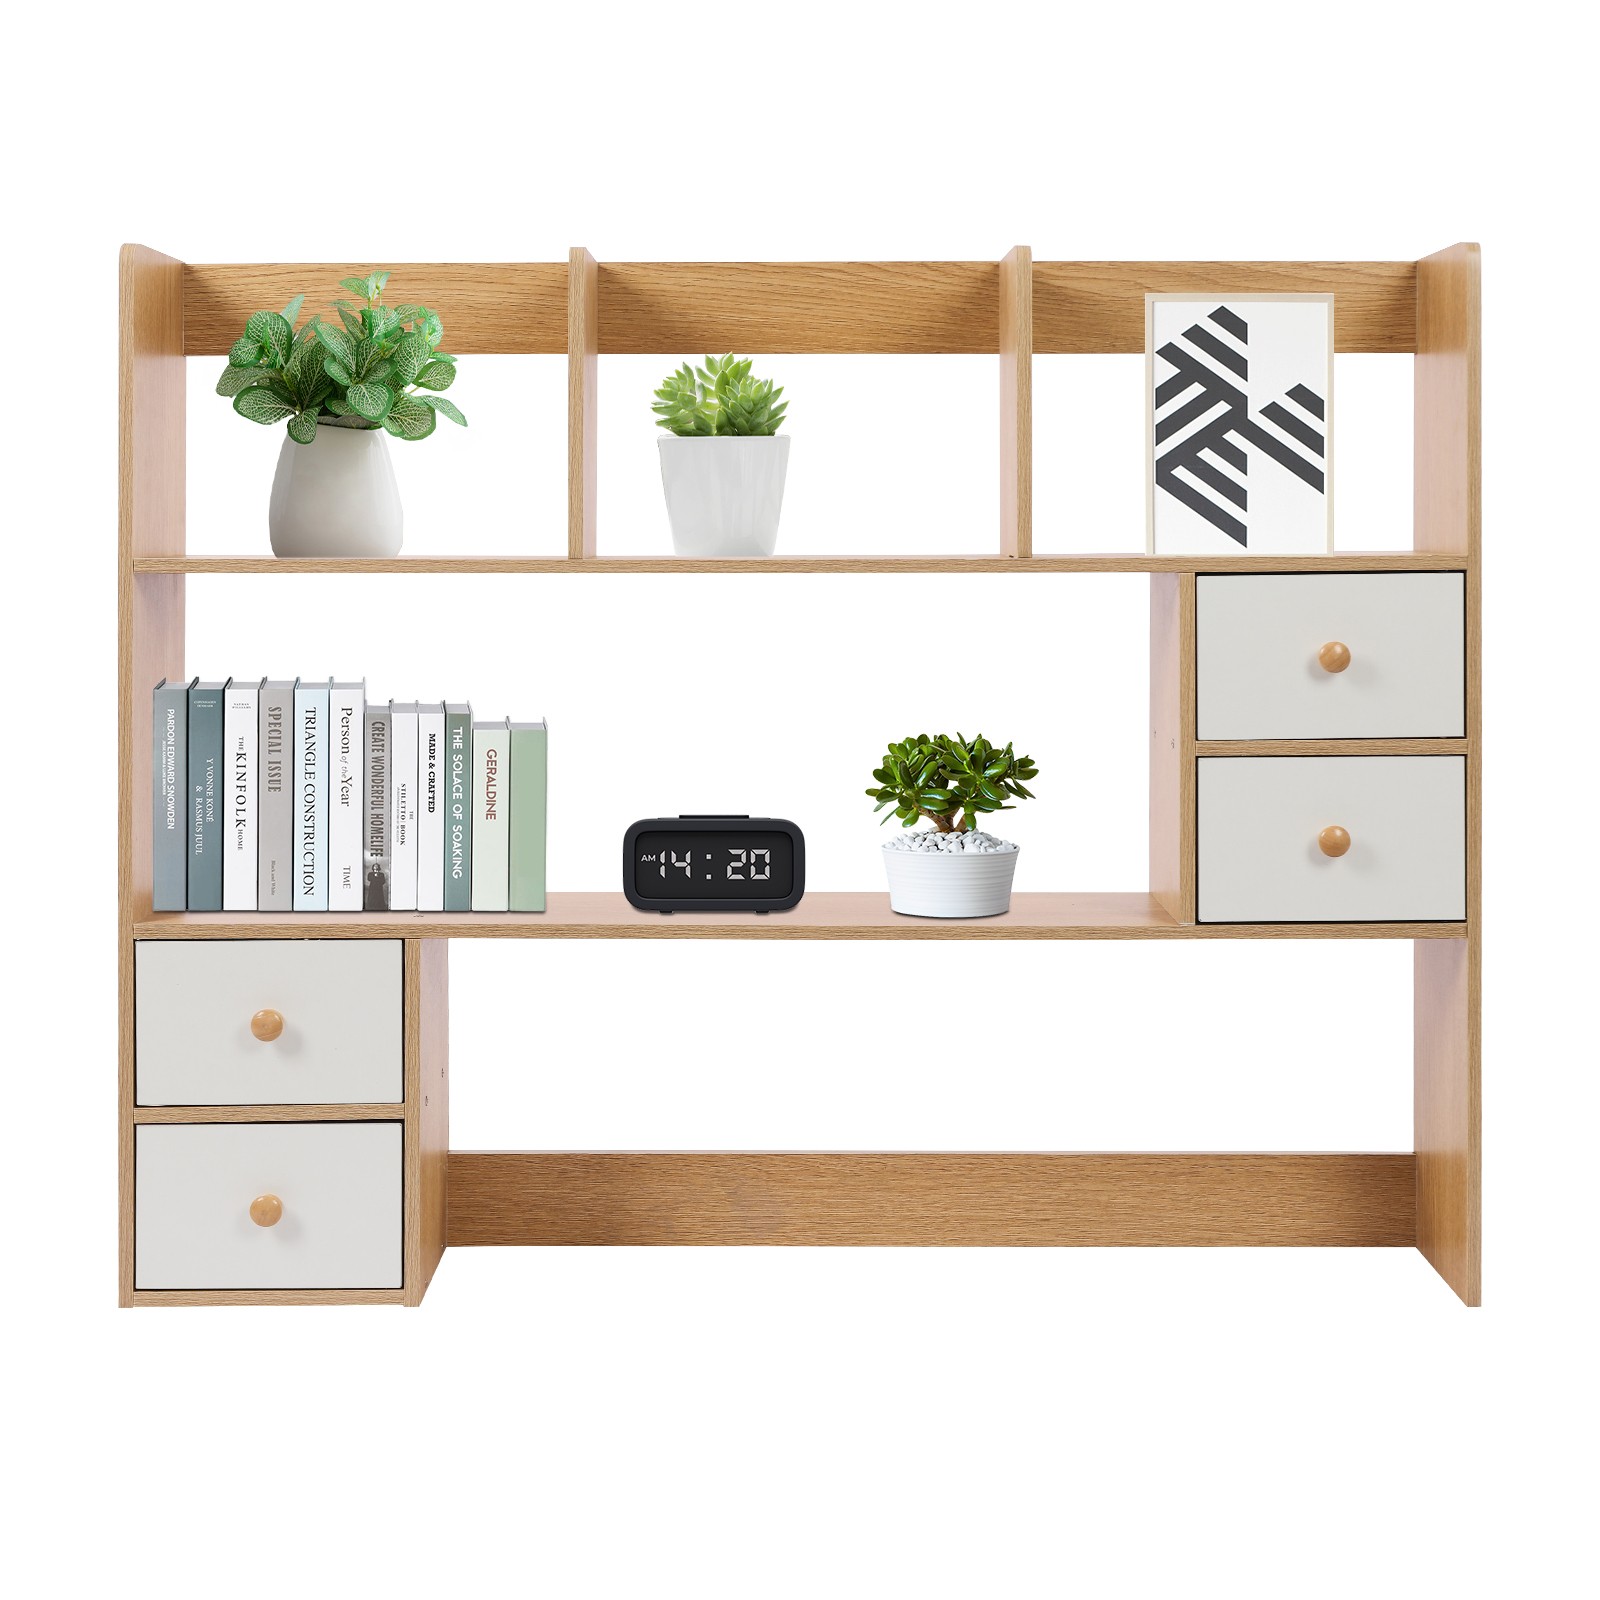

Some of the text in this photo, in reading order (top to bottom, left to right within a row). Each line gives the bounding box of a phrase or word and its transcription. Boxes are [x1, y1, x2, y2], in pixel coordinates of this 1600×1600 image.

[166, 709, 176, 829] PARDON EDWARD SNOWDEN
[206, 766, 214, 796] VONNE
[267, 706, 282, 792] SPECIAL ISSUE
[340, 707, 353, 807] Person of the Year
[485, 749, 498, 820] GERALDINE
[206, 798, 215, 822] KONÉ
[235, 752, 247, 828] KINFOLK
[302, 707, 316, 896] TRIANGLE CONSTRUCTION
[370, 721, 386, 857] CREATE WONDERFUL HOMELIFE
[427, 772, 436, 813] CRAFTED
[452, 727, 463, 879] THE SOLACE OF SOAKING
[194, 833, 203, 855] JUUL
[342, 866, 351, 889] TIME
[641, 854, 656, 862] AM
